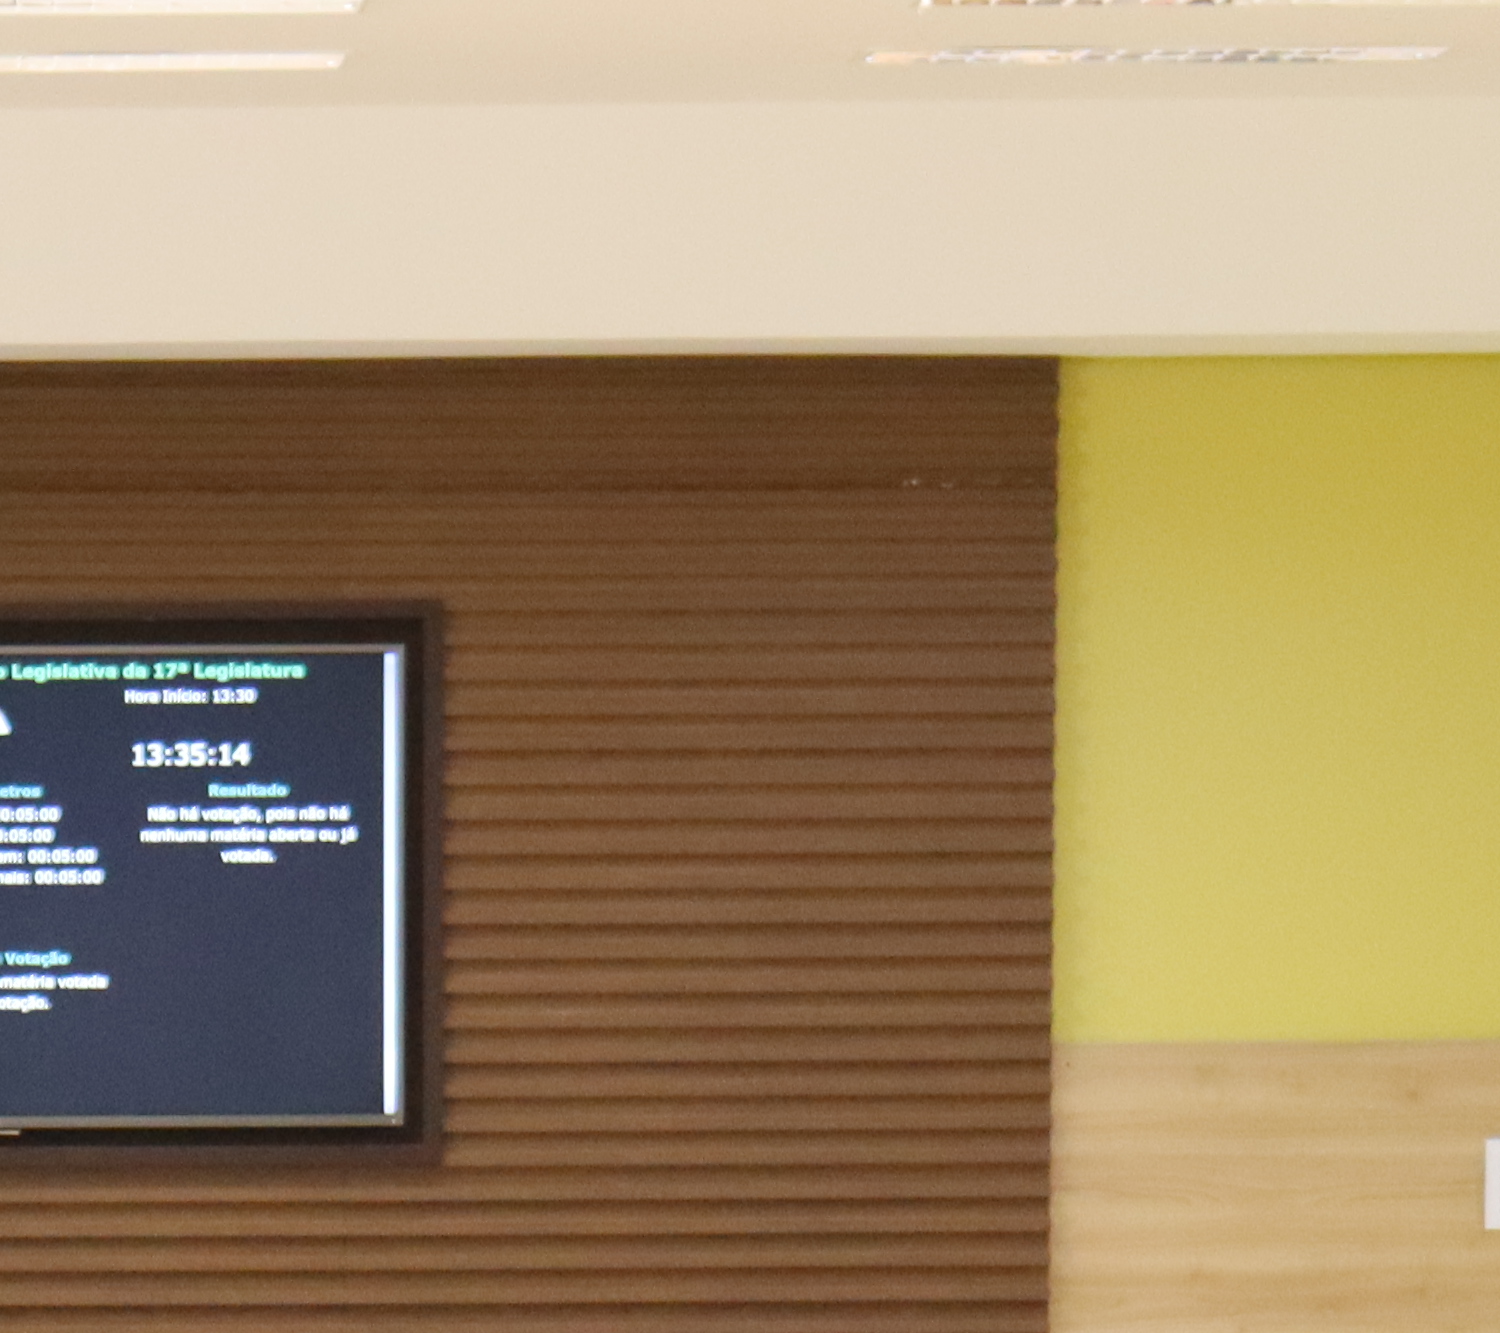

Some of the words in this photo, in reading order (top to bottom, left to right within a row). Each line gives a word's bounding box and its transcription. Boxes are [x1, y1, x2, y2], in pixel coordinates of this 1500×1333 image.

[11, 661, 120, 683] Legislativa
[122, 662, 150, 680] da
[153, 661, 190, 680] 17ª
[193, 661, 306, 682] Legislatura
[124, 687, 162, 704] Hora
[163, 687, 208, 704] Início:
[212, 687, 258, 704] 13:30
[131, 741, 252, 767] 13:35:14
[208, 783, 290, 798] Resultado
[147, 806, 177, 822] Não
[179, 806, 199, 822] há
[200, 805, 263, 824] votação,
[265, 806, 297, 823] pois
[299, 805, 328, 822] não
[329, 805, 351, 821] há
[139, 828, 208, 843] nenhuma
[210, 827, 267, 843] matéria
[268, 827, 317, 843] aberta
[318, 828, 339, 843] ou
[339, 825, 359, 845] já
[27, 846, 98, 865] 00:05:00
[220, 848, 278, 864] votada.
[34, 867, 106, 886] 00:05:00
[3, 949, 73, 968] Votação
[0, 973, 57, 990] matéria
[57, 973, 109, 990] votada
